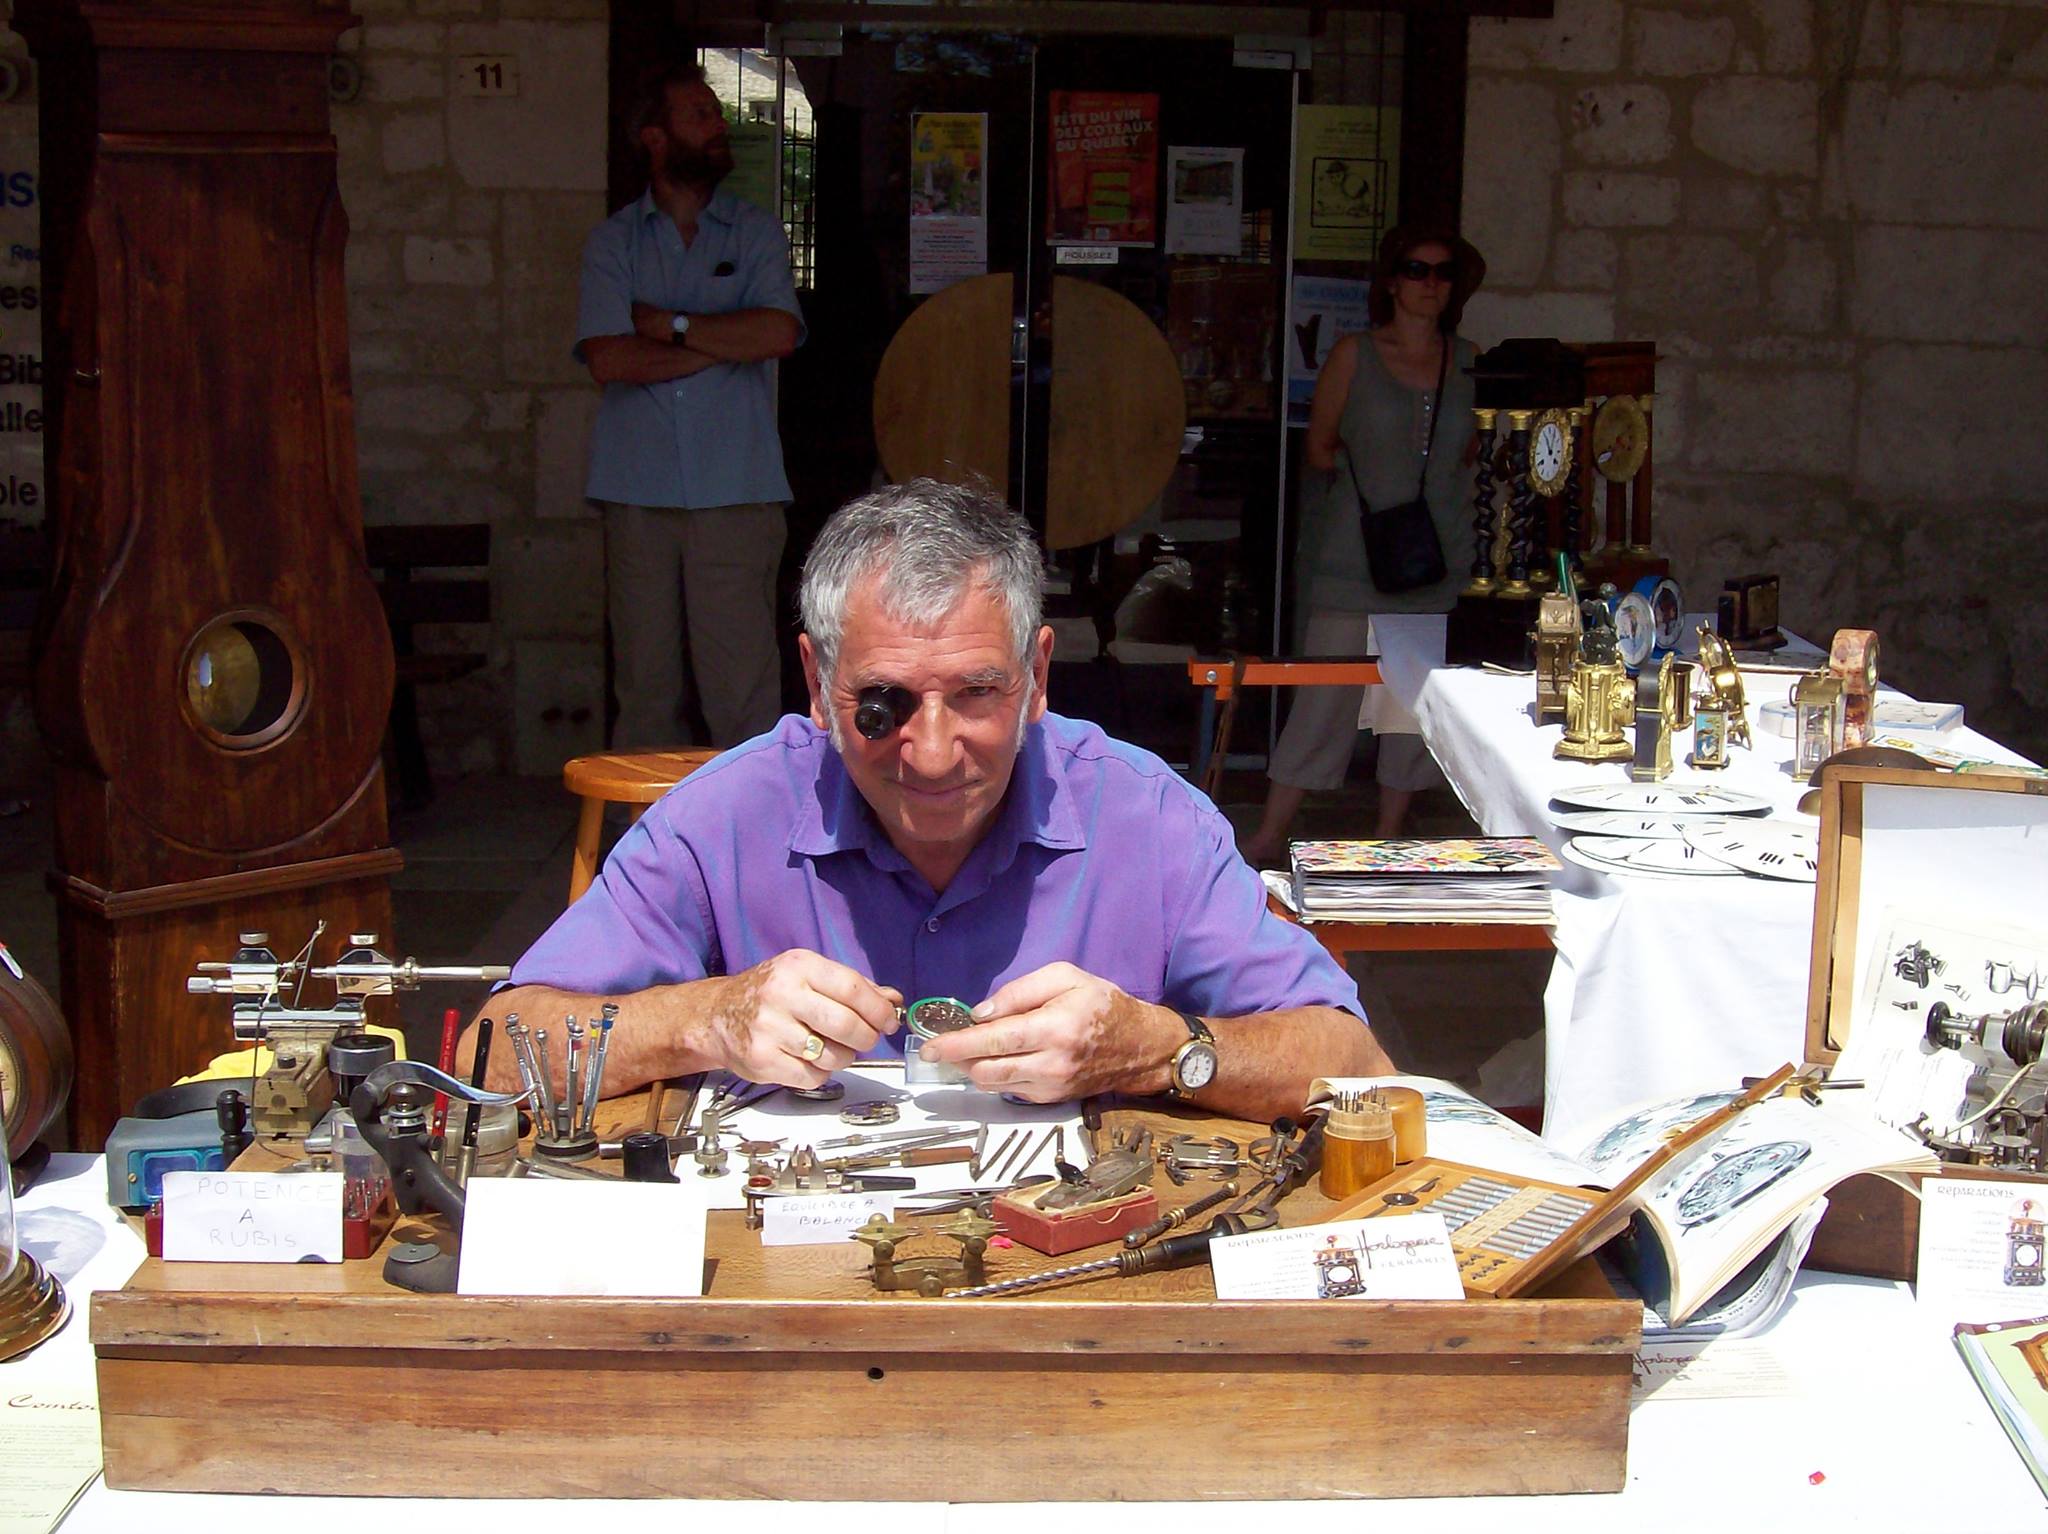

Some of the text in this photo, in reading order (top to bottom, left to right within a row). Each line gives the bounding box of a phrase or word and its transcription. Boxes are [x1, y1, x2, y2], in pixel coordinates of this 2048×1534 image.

[474, 63, 502, 89] 11
[1088, 111, 1111, 123] DU
[1113, 108, 1141, 121] VIN
[1055, 120, 1152, 139] DES COTEAUX
[1055, 140, 1077, 152] DU
[198, 1176, 337, 1203] POTENCE
[238, 1208, 255, 1224] A
[209, 1228, 298, 1248] RUBIS
